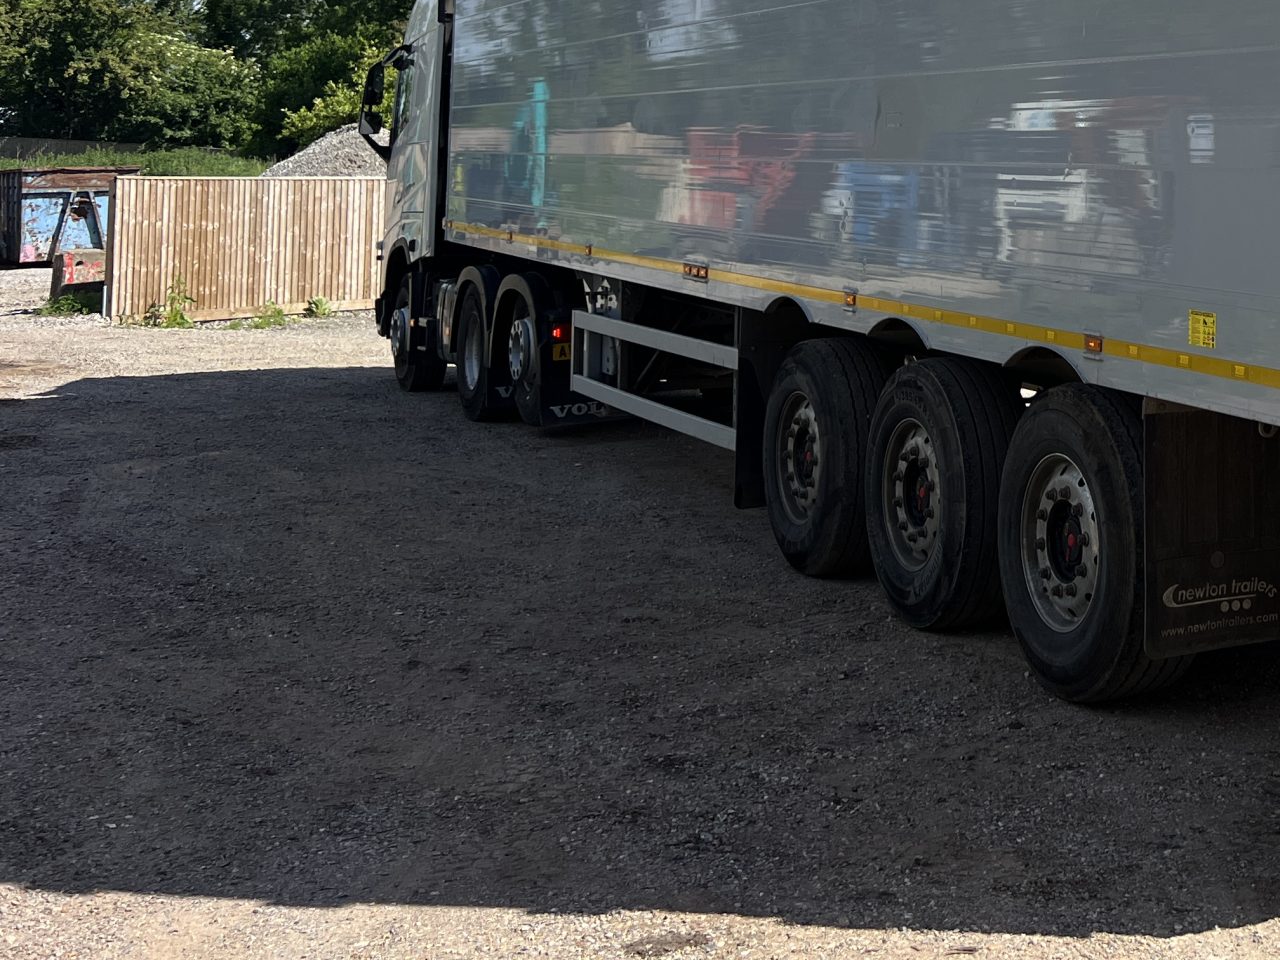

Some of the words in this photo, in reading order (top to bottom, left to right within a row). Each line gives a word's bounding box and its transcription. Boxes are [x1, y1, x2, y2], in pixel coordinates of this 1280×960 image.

[548, 401, 606, 418] VOL
[1178, 583, 1227, 601] newton
[1231, 577, 1278, 598] trailers
[1160, 613, 1279, 638] www.newtontrailers.com
